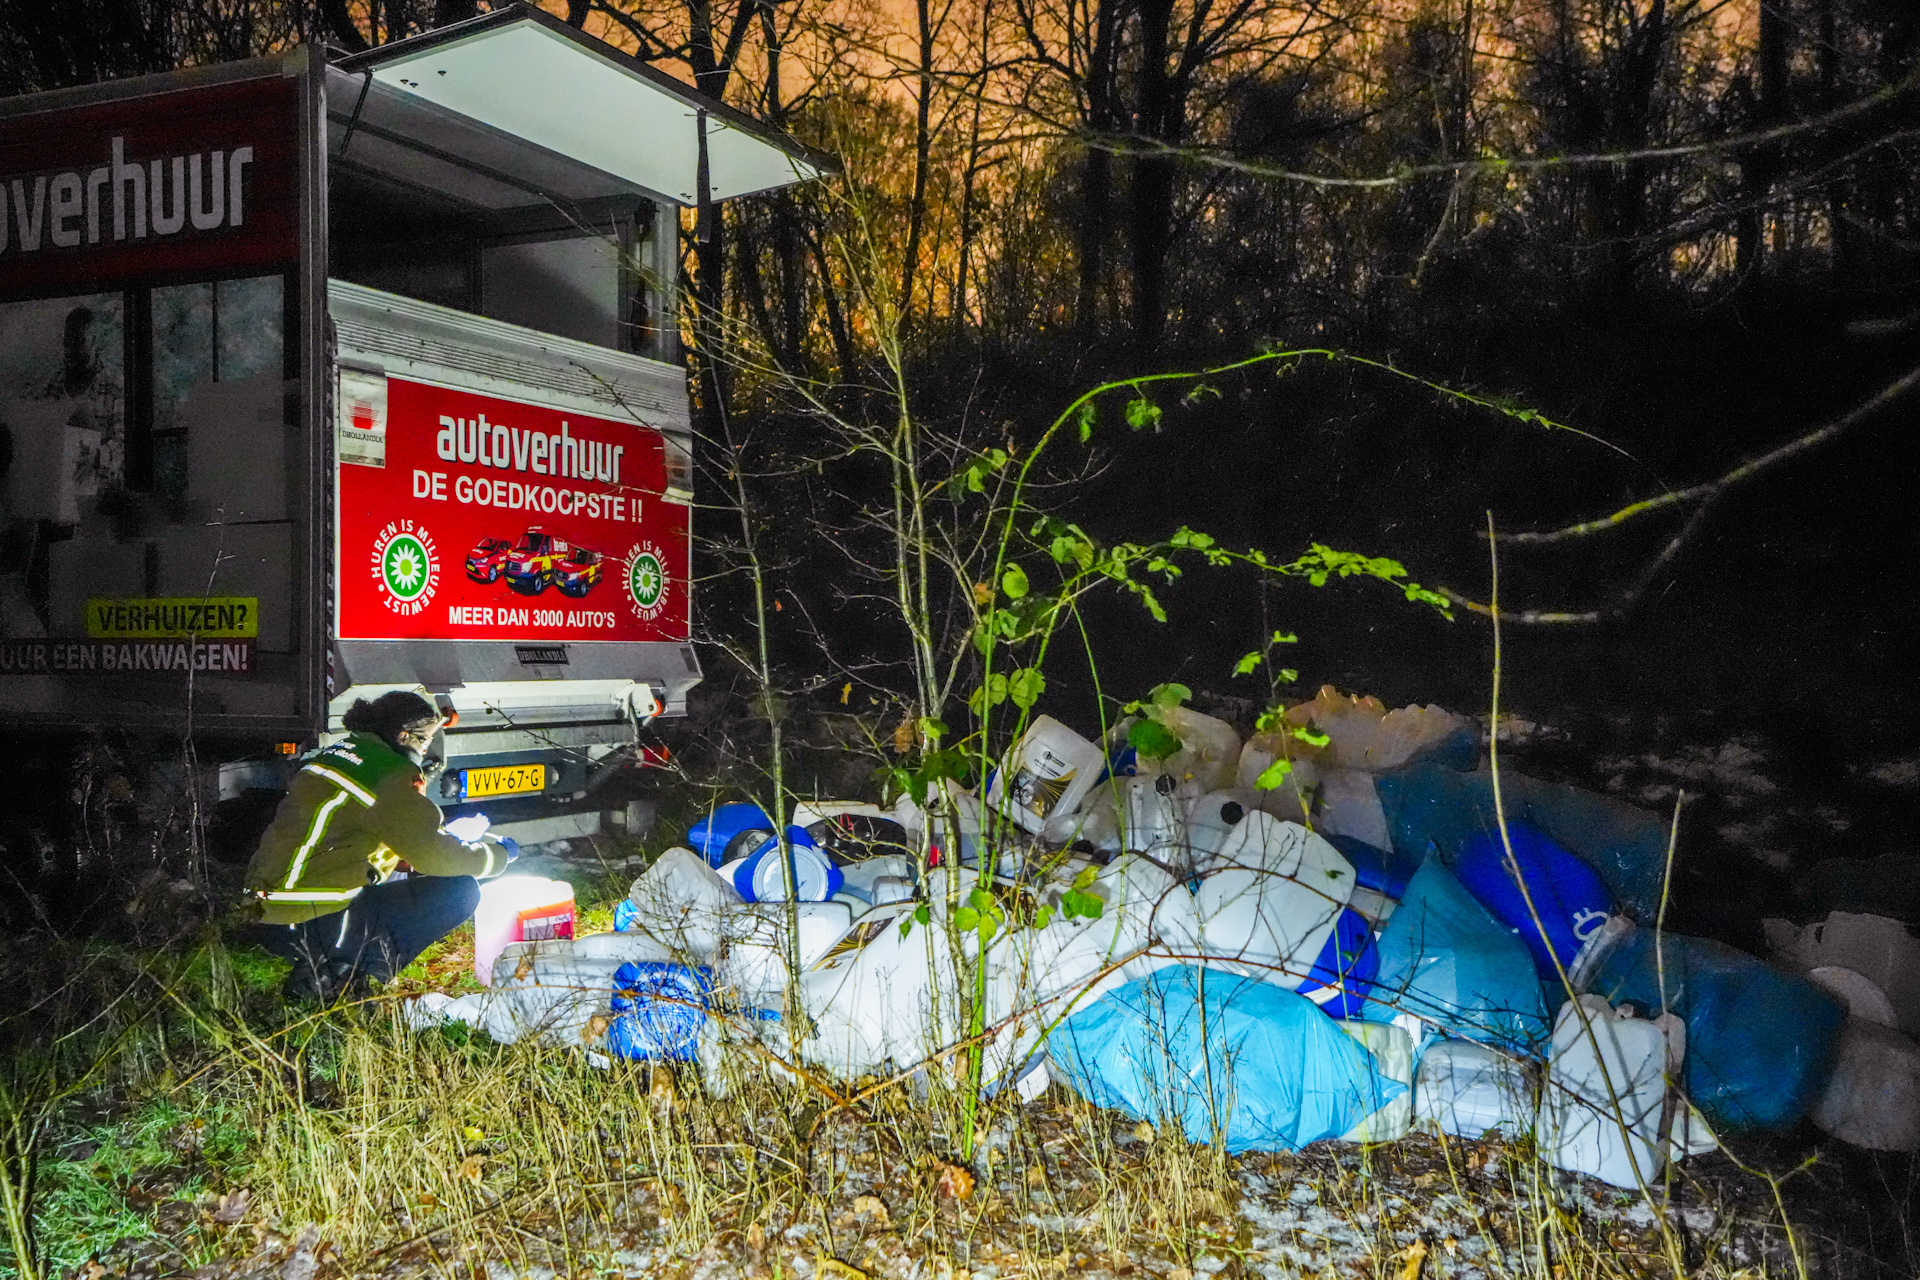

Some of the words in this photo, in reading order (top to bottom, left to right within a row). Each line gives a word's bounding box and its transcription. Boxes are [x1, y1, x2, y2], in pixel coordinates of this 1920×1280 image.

[0, 136, 253, 255] verhuur
[342, 430, 383, 444] DHOLLANDIA
[437, 413, 623, 483] autoverhuur
[413, 469, 447, 501] DE
[455, 475, 625, 521] GOEDKOOPSTE
[401, 518, 414, 532] IS
[371, 521, 398, 579] HUREN
[643, 540, 652, 551] IS
[383, 526, 441, 616] MILIEUBEWUST
[631, 546, 671, 621] MILIEUBEWUST
[97, 604, 248, 631] VERHUIZEN?
[449, 605, 494, 626] MEER
[497, 607, 529, 627] DAN
[532, 609, 564, 627] 3000
[566, 610, 616, 628] AUTO'S
[53, 643, 97, 671] EEN
[102, 643, 249, 671] BAKWAGEN!
[473, 769, 539, 792] VVV-67-G
